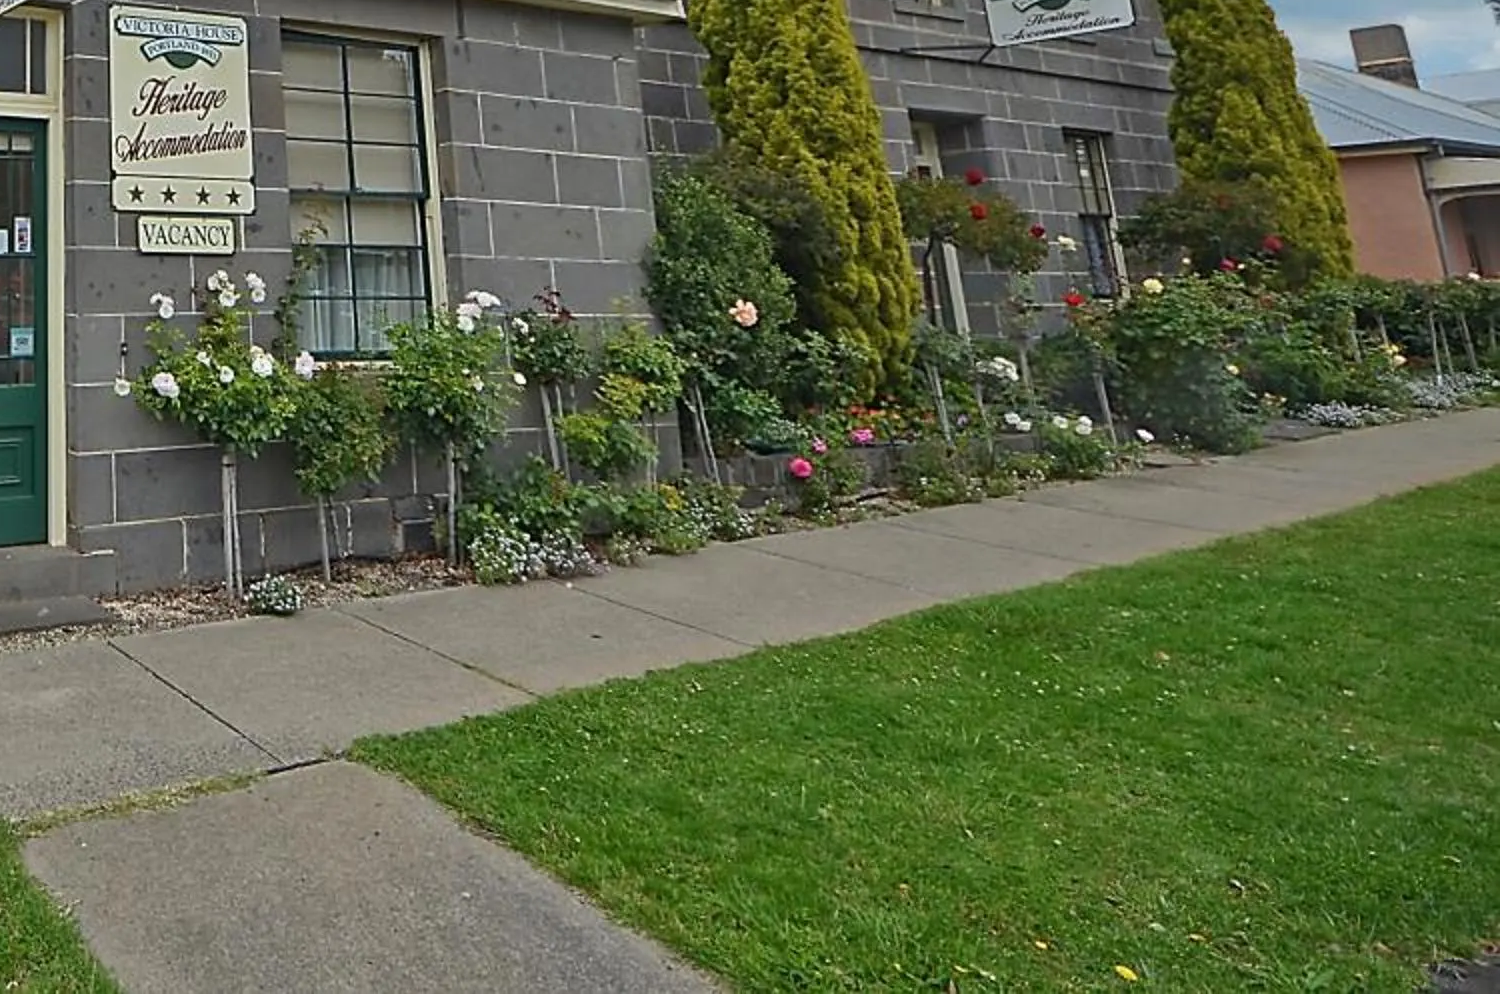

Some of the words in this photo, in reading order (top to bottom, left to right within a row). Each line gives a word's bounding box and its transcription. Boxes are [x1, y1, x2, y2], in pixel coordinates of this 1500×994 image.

[122, 17, 190, 37] VICTORIA
[195, 24, 238, 41] HOUSE
[148, 39, 200, 56] PORTLAND
[132, 75, 228, 120] Heritage
[115, 121, 248, 162] Accommodation
[142, 223, 231, 247] VACANCY
